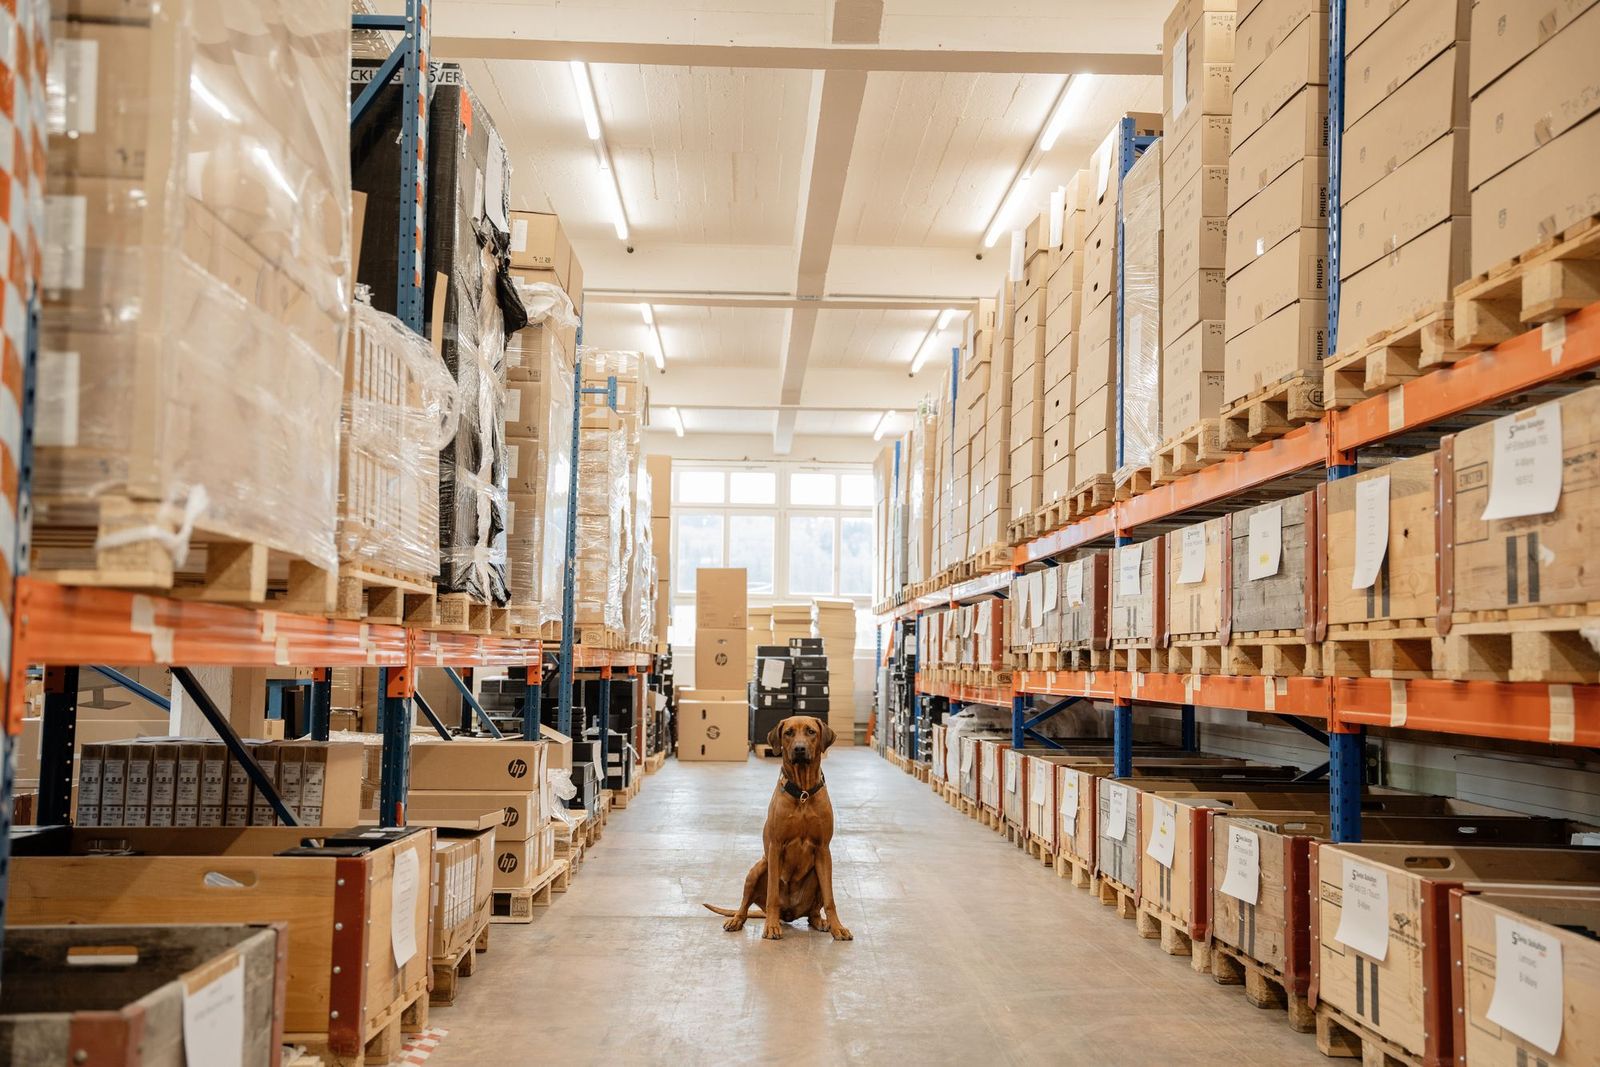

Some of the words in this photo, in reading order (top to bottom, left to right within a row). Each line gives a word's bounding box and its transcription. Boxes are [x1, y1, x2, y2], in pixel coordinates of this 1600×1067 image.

[1319, 187, 1327, 217] PHILIPS
[508, 759, 527, 778] hp
[498, 852, 517, 873] hp
